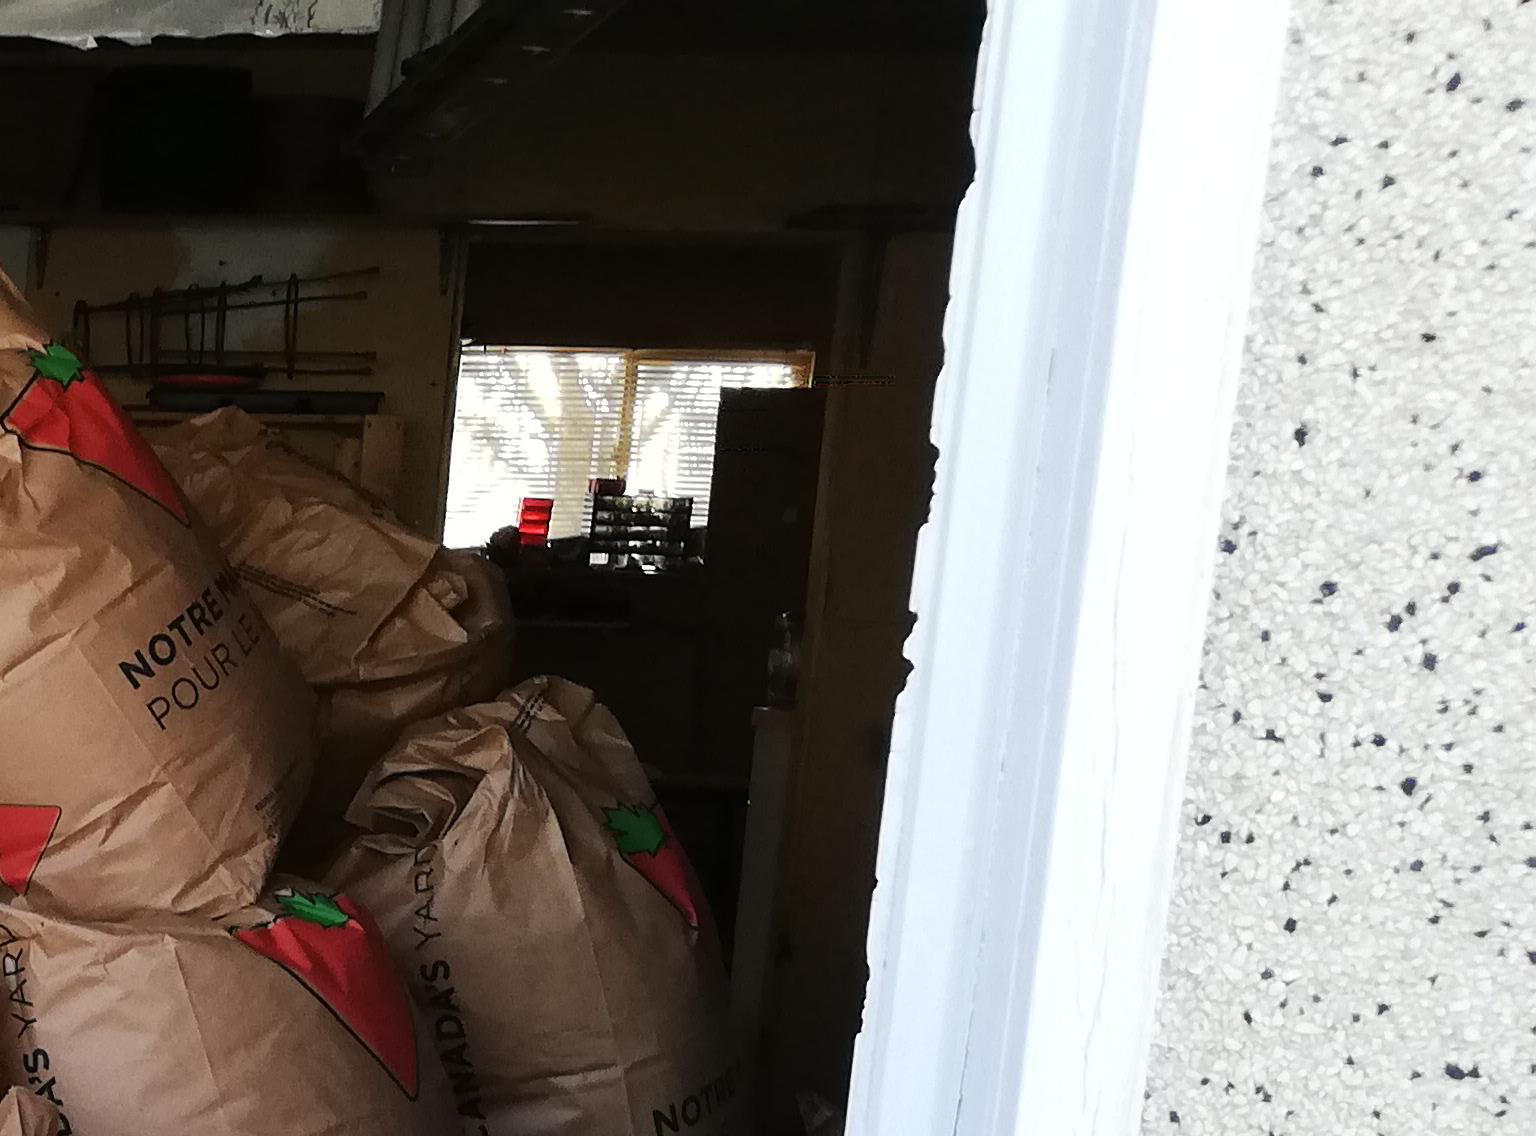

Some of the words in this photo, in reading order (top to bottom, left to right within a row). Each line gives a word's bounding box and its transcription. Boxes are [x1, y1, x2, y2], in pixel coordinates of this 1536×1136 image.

[118, 587, 223, 690] NOTRE
[146, 643, 238, 730] POUR
[231, 614, 261, 656] LE
